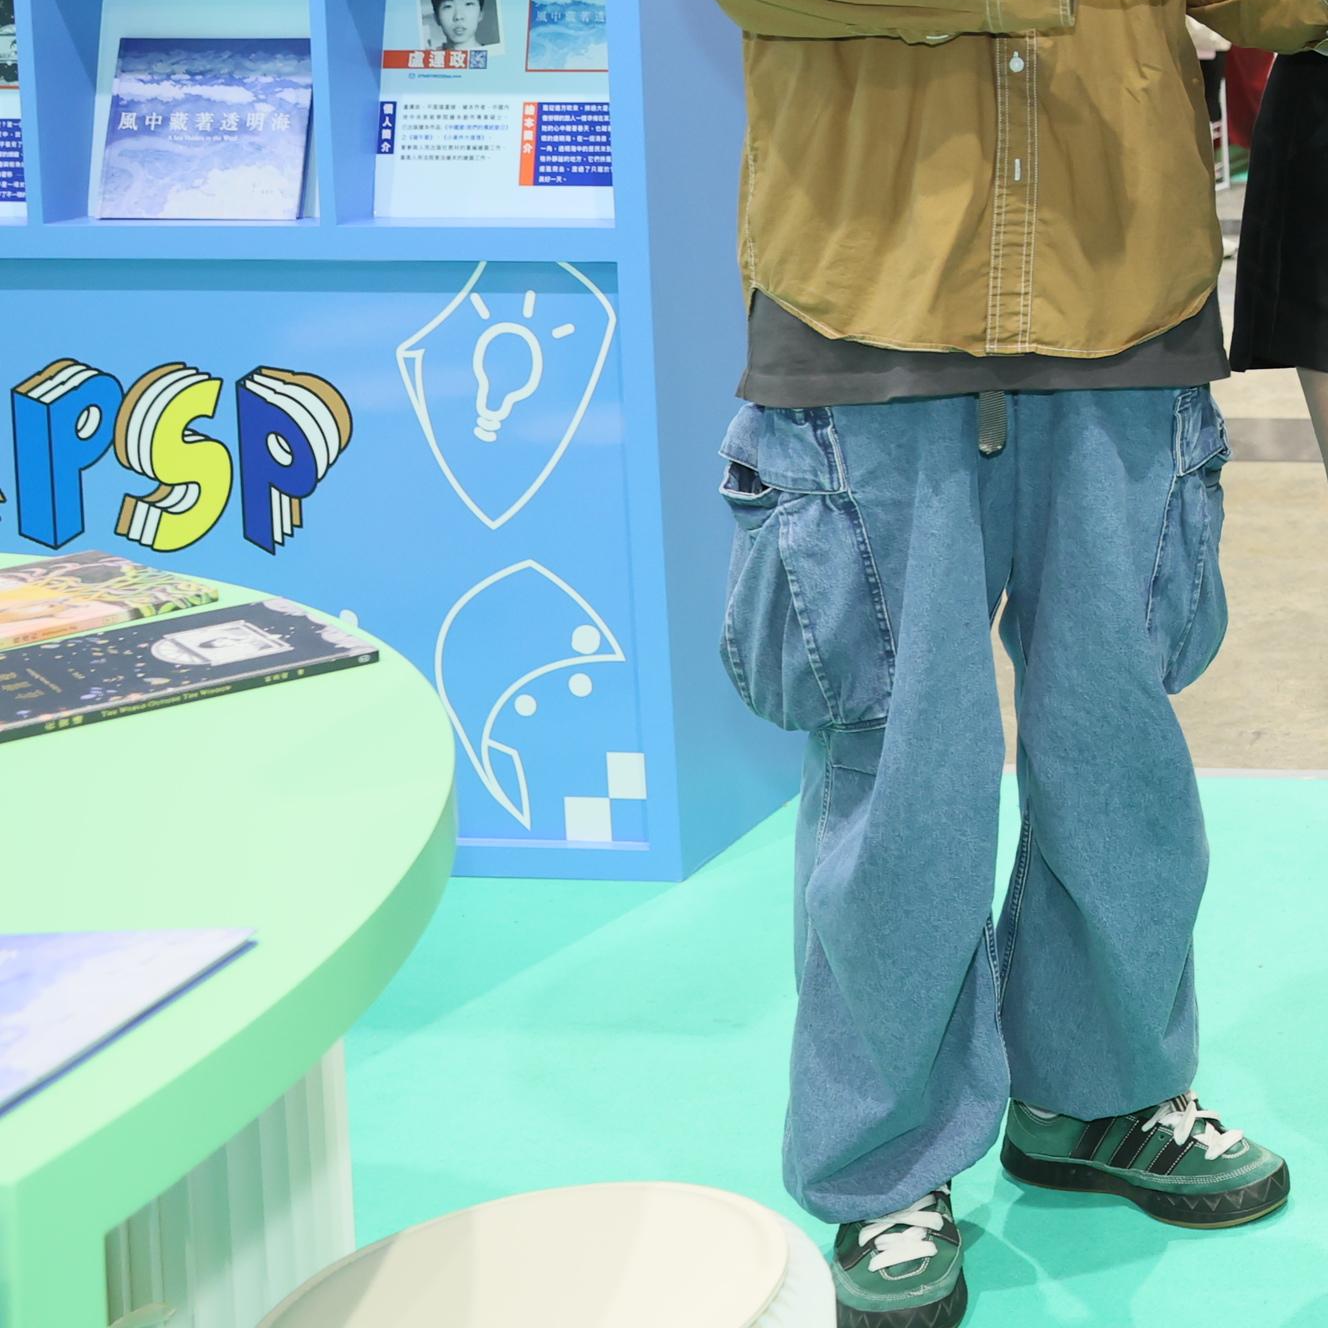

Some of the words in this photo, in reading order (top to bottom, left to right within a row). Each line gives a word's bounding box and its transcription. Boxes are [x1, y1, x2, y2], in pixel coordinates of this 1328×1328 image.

[118, 111, 291, 132] 風中藏著透明海
[0, 357, 353, 556] PSP
